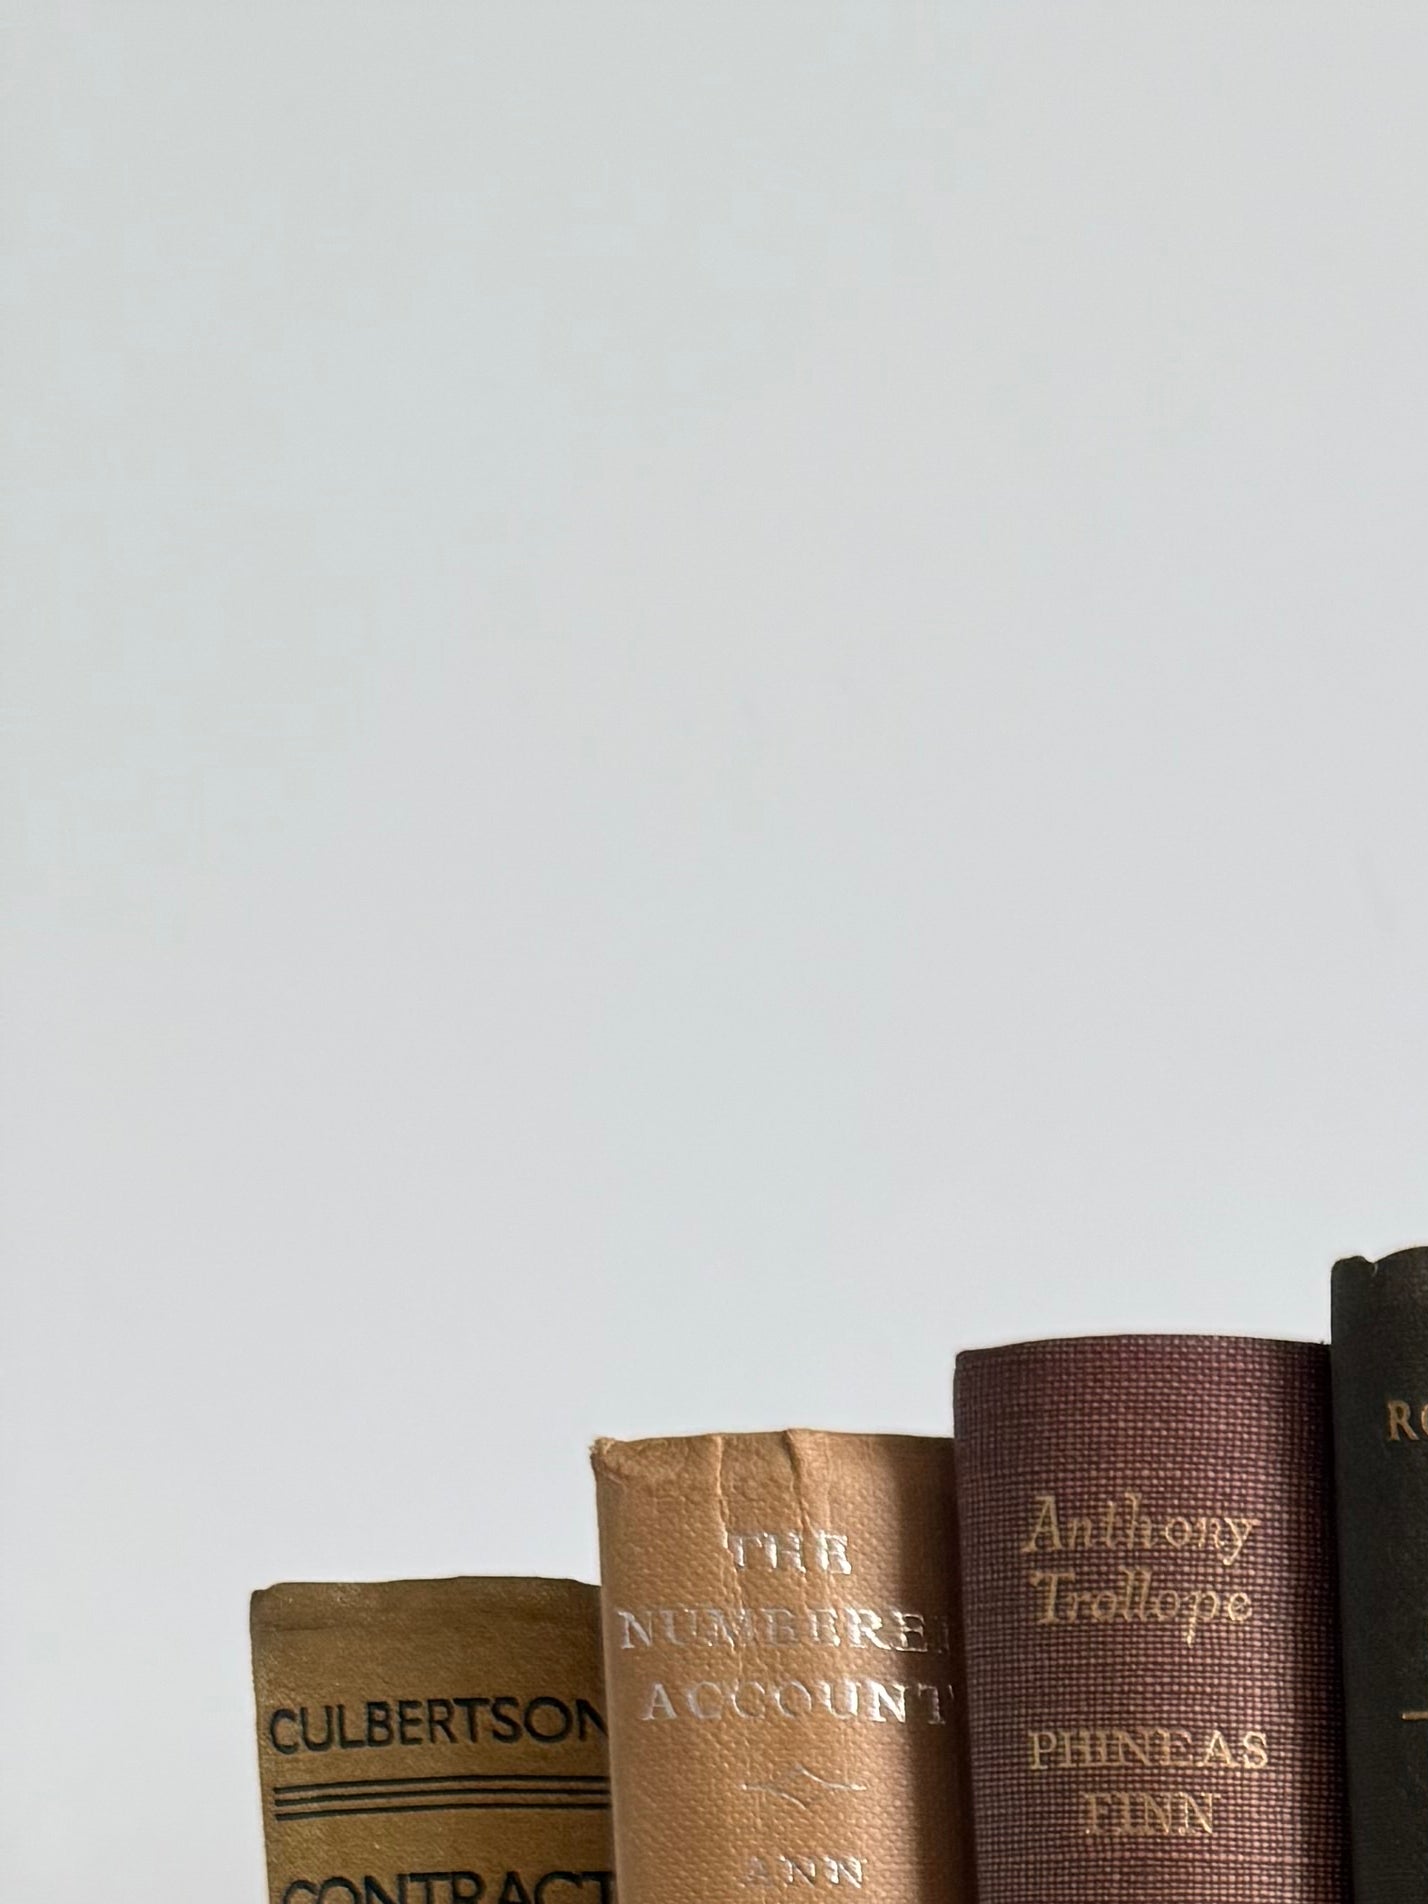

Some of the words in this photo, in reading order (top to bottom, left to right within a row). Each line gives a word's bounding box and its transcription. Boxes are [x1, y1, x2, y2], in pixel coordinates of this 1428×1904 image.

[1021, 1492, 1261, 1567] Anthony
[726, 1530, 852, 1576] THE
[1030, 1567, 1255, 1646] Trollope
[268, 1696, 608, 1756] CULBERTSON
[640, 1680, 955, 1726] ACCOUNT
[1028, 1728, 1269, 1772] PHINEAS
[1083, 1791, 1222, 1836] FINN
[745, 1855, 866, 1890] ANN
